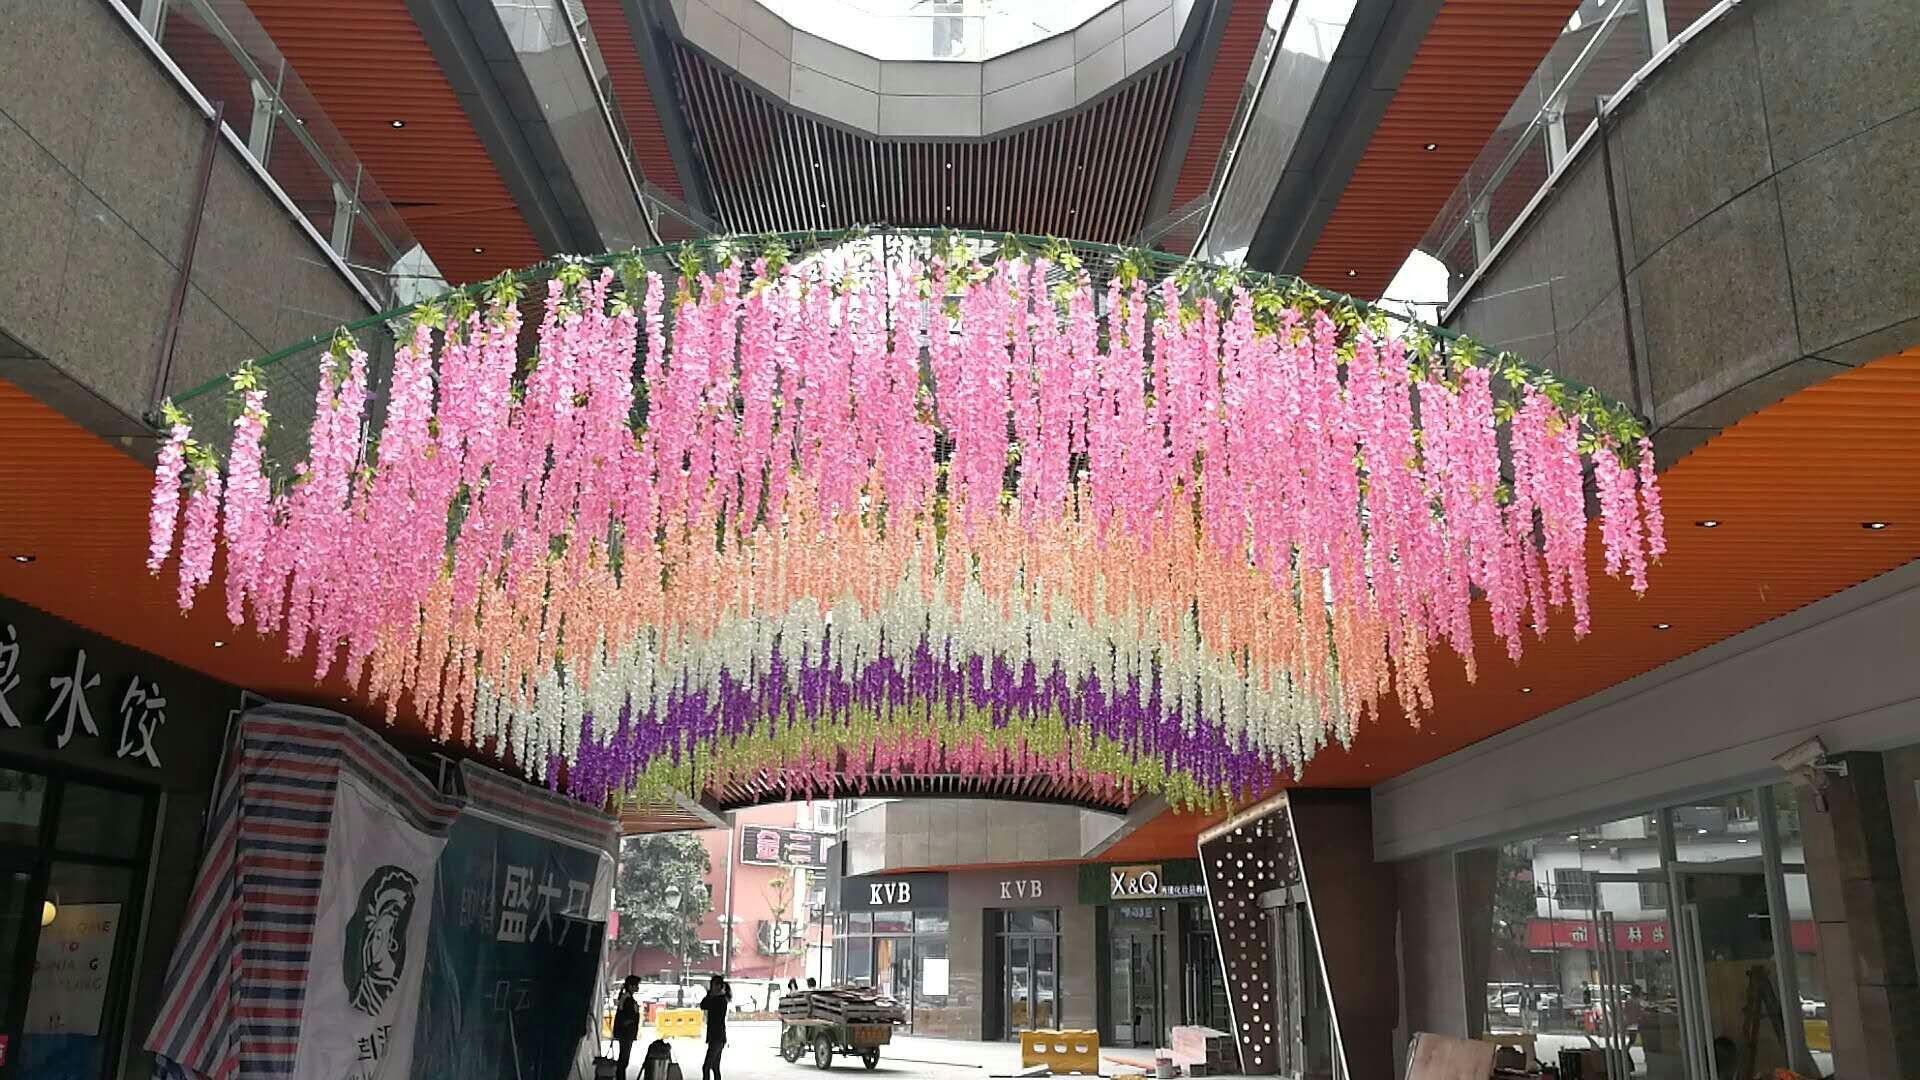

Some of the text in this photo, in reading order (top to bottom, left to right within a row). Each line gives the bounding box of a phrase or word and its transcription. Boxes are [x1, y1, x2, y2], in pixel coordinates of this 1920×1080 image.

[869, 882, 911, 905] KVB
[1000, 880, 1042, 899] KVB
[1112, 870, 1158, 895] X&Q
